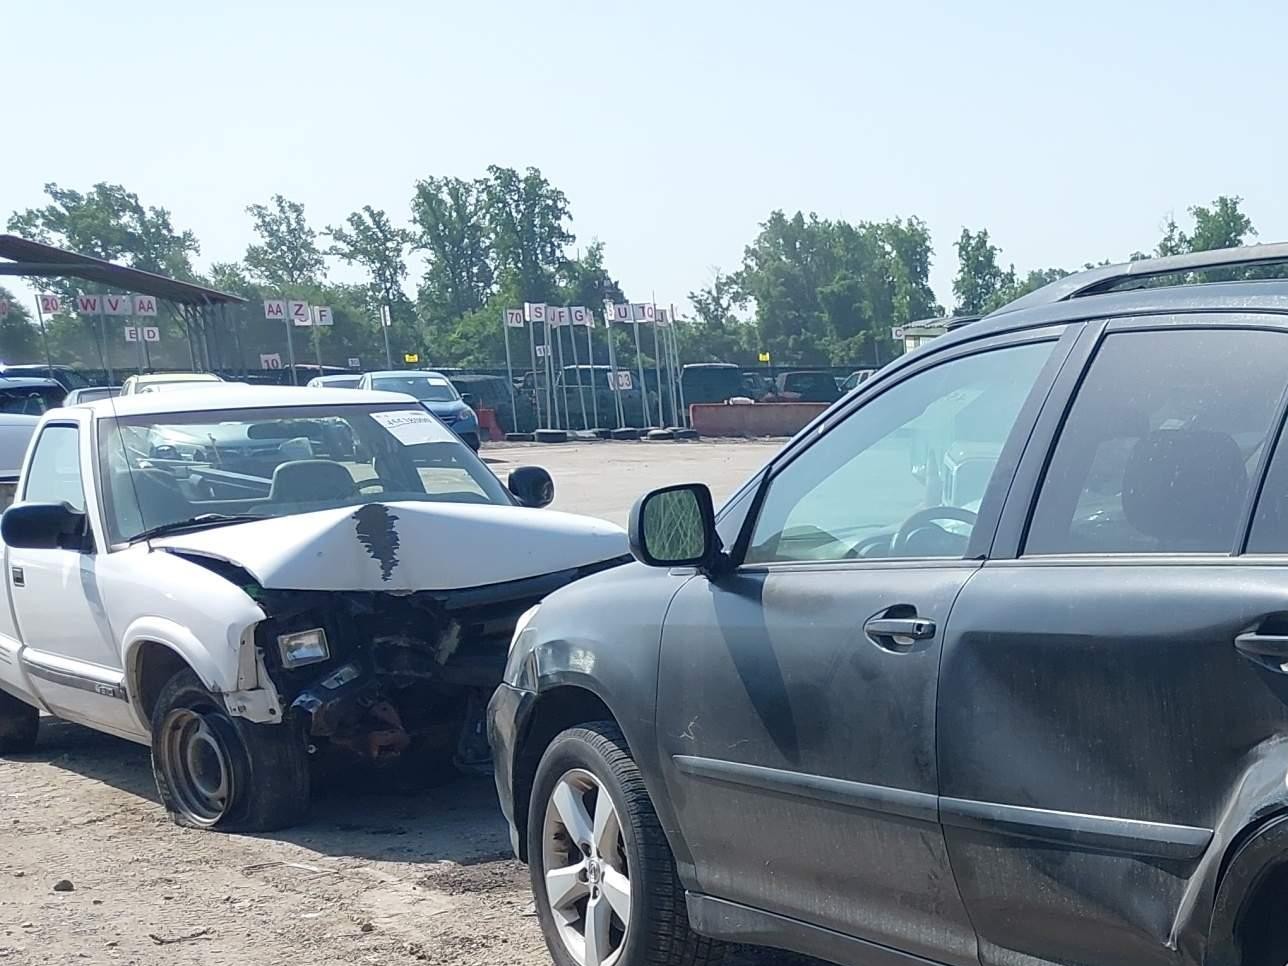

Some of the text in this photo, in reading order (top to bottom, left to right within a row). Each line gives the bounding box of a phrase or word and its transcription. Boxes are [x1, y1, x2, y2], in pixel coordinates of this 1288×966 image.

[42, 298, 59, 311] 20
[80, 298, 96, 311] W
[108, 298, 119, 311] V
[138, 299, 155, 313] AA
[267, 303, 283, 316] AA
[294, 304, 305, 316] Z
[319, 310, 327, 321] F
[534, 307, 543, 319] S
[574, 310, 583, 322] G
[618, 306, 628, 318] U
[508, 312, 521, 325] 70
[147, 329, 156, 339] D
[263, 358, 278, 368] 10
